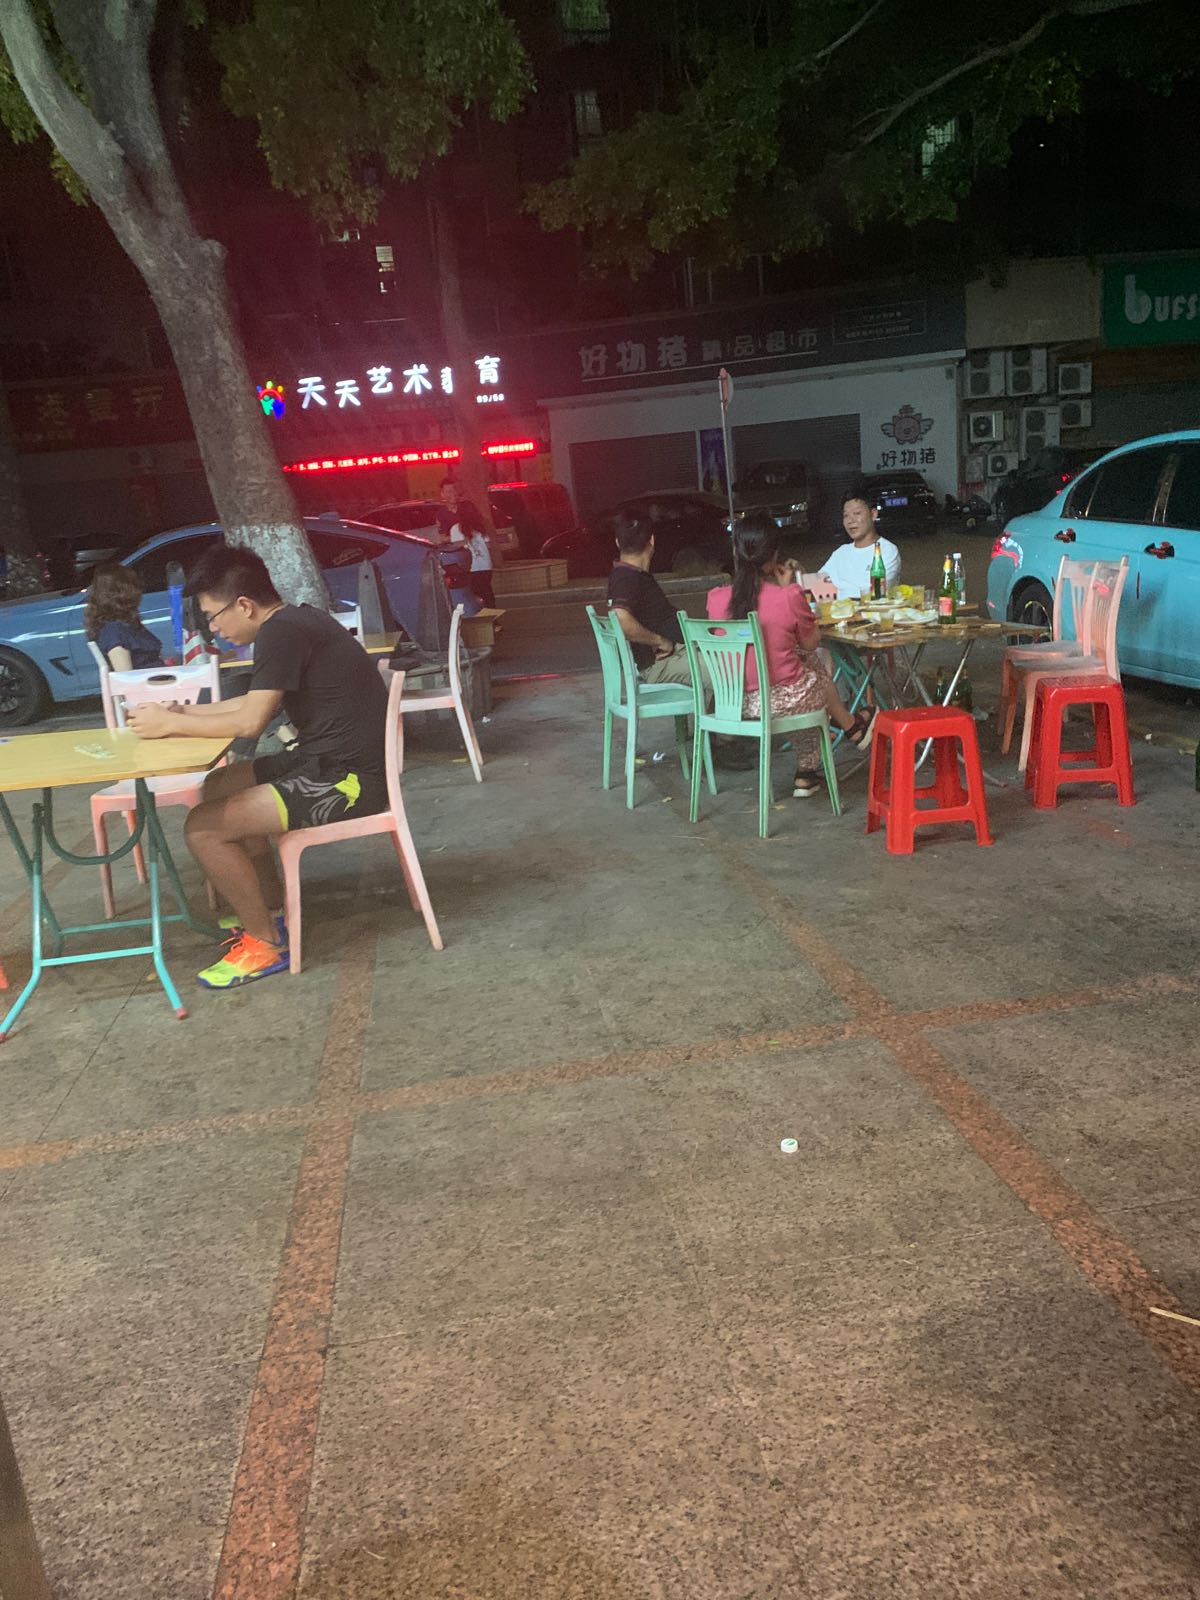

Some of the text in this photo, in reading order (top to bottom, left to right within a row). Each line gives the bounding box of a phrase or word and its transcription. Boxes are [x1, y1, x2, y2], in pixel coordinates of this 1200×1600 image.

[578, 335, 688, 377] 好物猪
[881, 448, 936, 467] 好物猪
